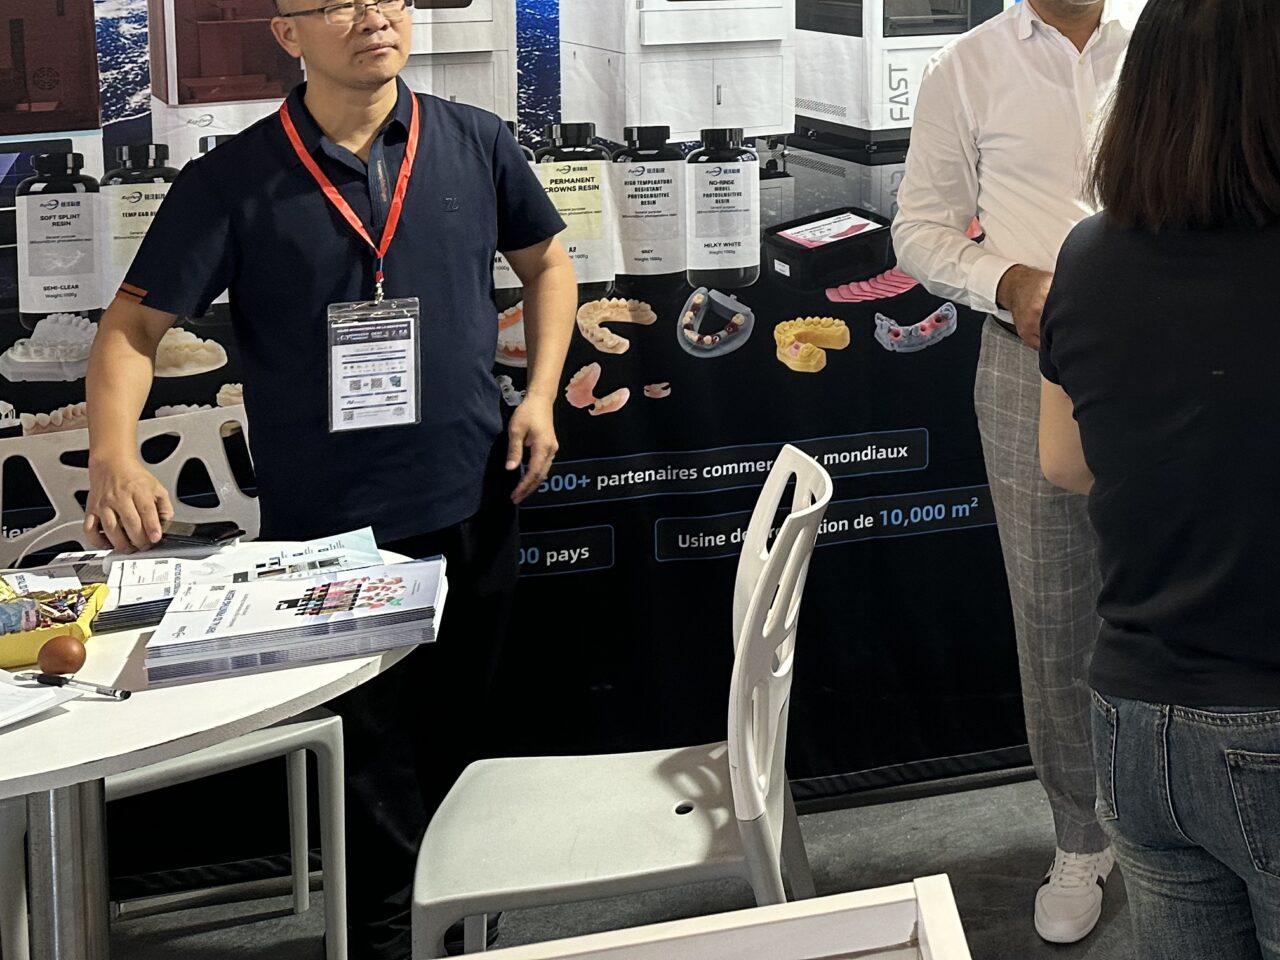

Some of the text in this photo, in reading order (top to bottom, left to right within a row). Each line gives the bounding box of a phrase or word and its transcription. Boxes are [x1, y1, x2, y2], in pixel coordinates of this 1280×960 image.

[888, 63, 910, 122] FAST
[549, 176, 595, 185] PERMANENT
[578, 184, 600, 192] RESIN
[597, 465, 698, 490] partenaires
[702, 460, 774, 480] commer
[823, 443, 908, 466] mondiaux
[678, 532, 726, 548] Usine
[853, 515, 874, 529] de
[879, 503, 946, 527] 10,000
[546, 546, 590, 566] pays
